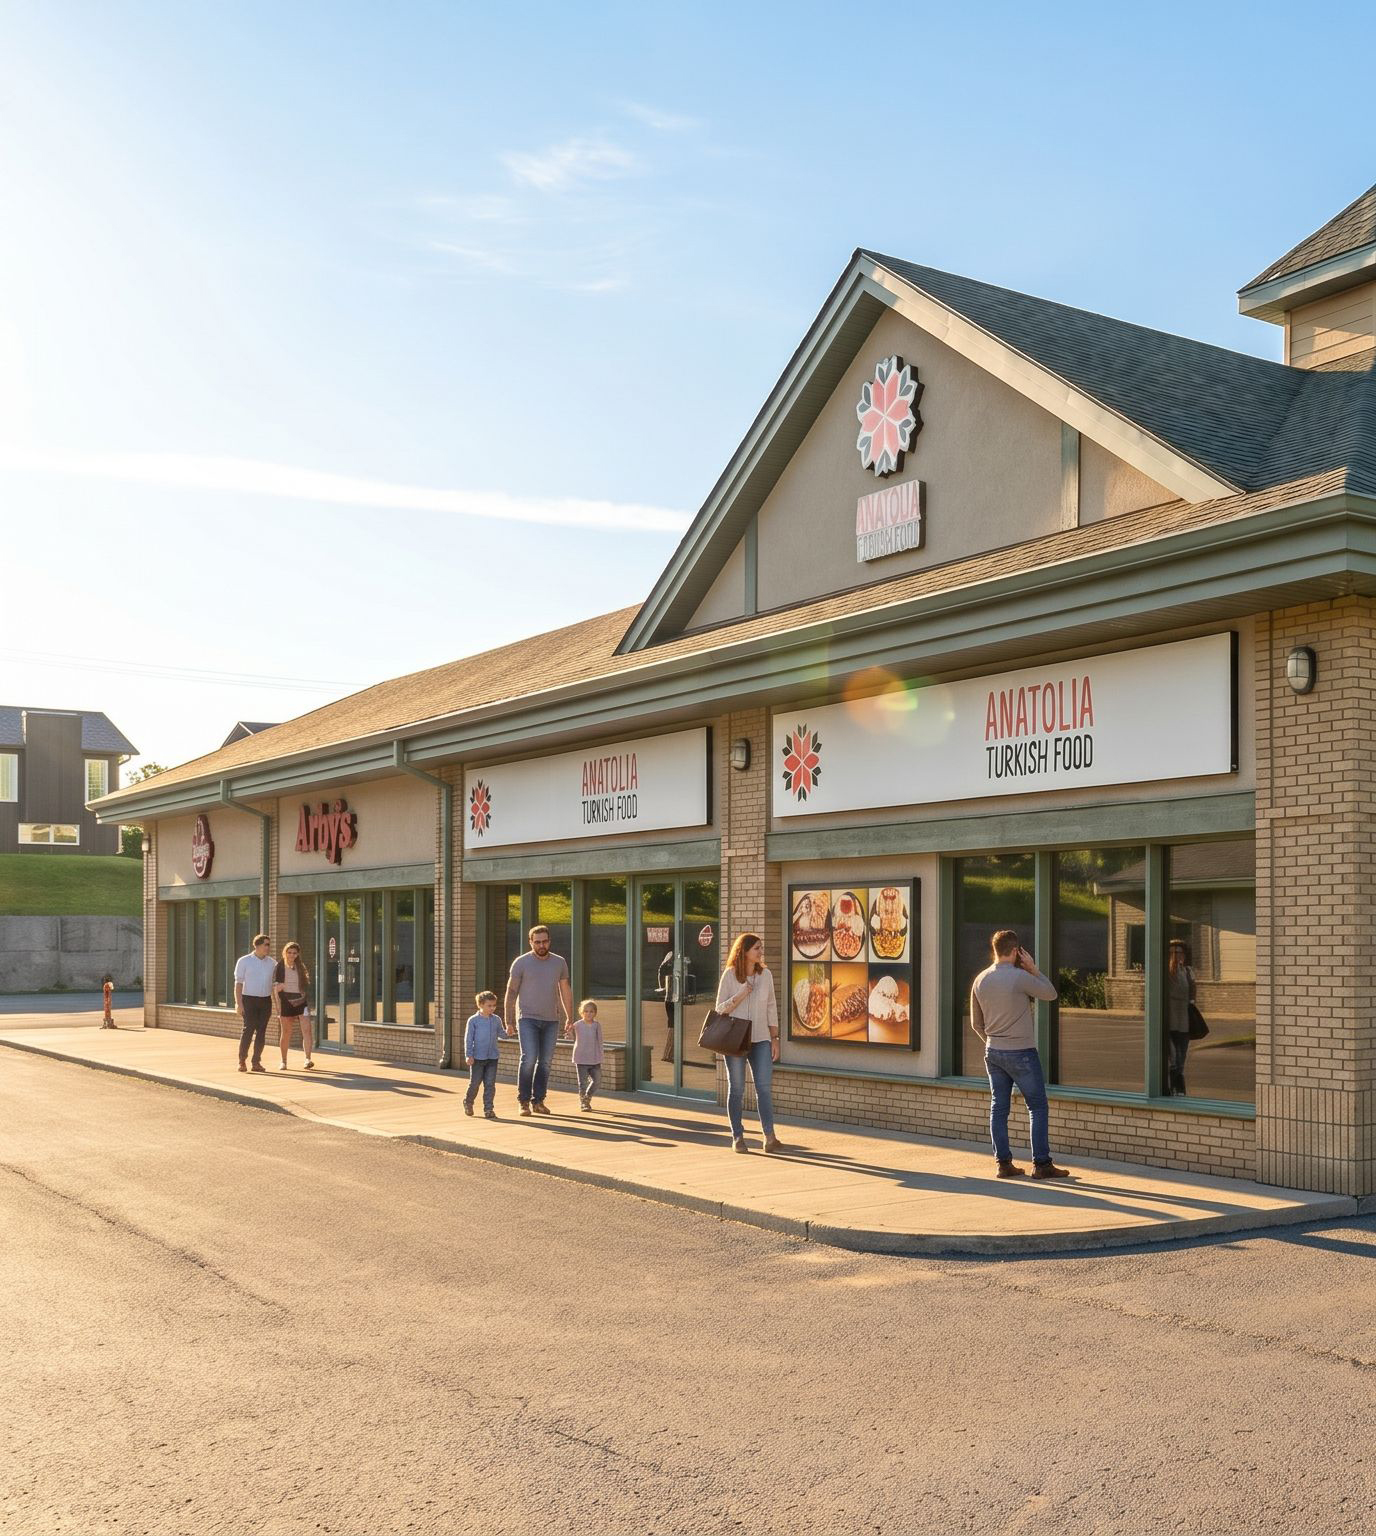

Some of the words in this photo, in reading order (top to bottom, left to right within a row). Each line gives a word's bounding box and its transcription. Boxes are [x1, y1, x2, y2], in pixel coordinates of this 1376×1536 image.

[985, 676, 1094, 742] ANATOLIA
[582, 753, 638, 797] ANATOLIA
[986, 739, 1049, 779] TURKISH
[1054, 734, 1094, 772] FOOD
[581, 798, 615, 825] TURKISH
[617, 793, 638, 821] FOOD
[295, 799, 355, 865] Arby's
